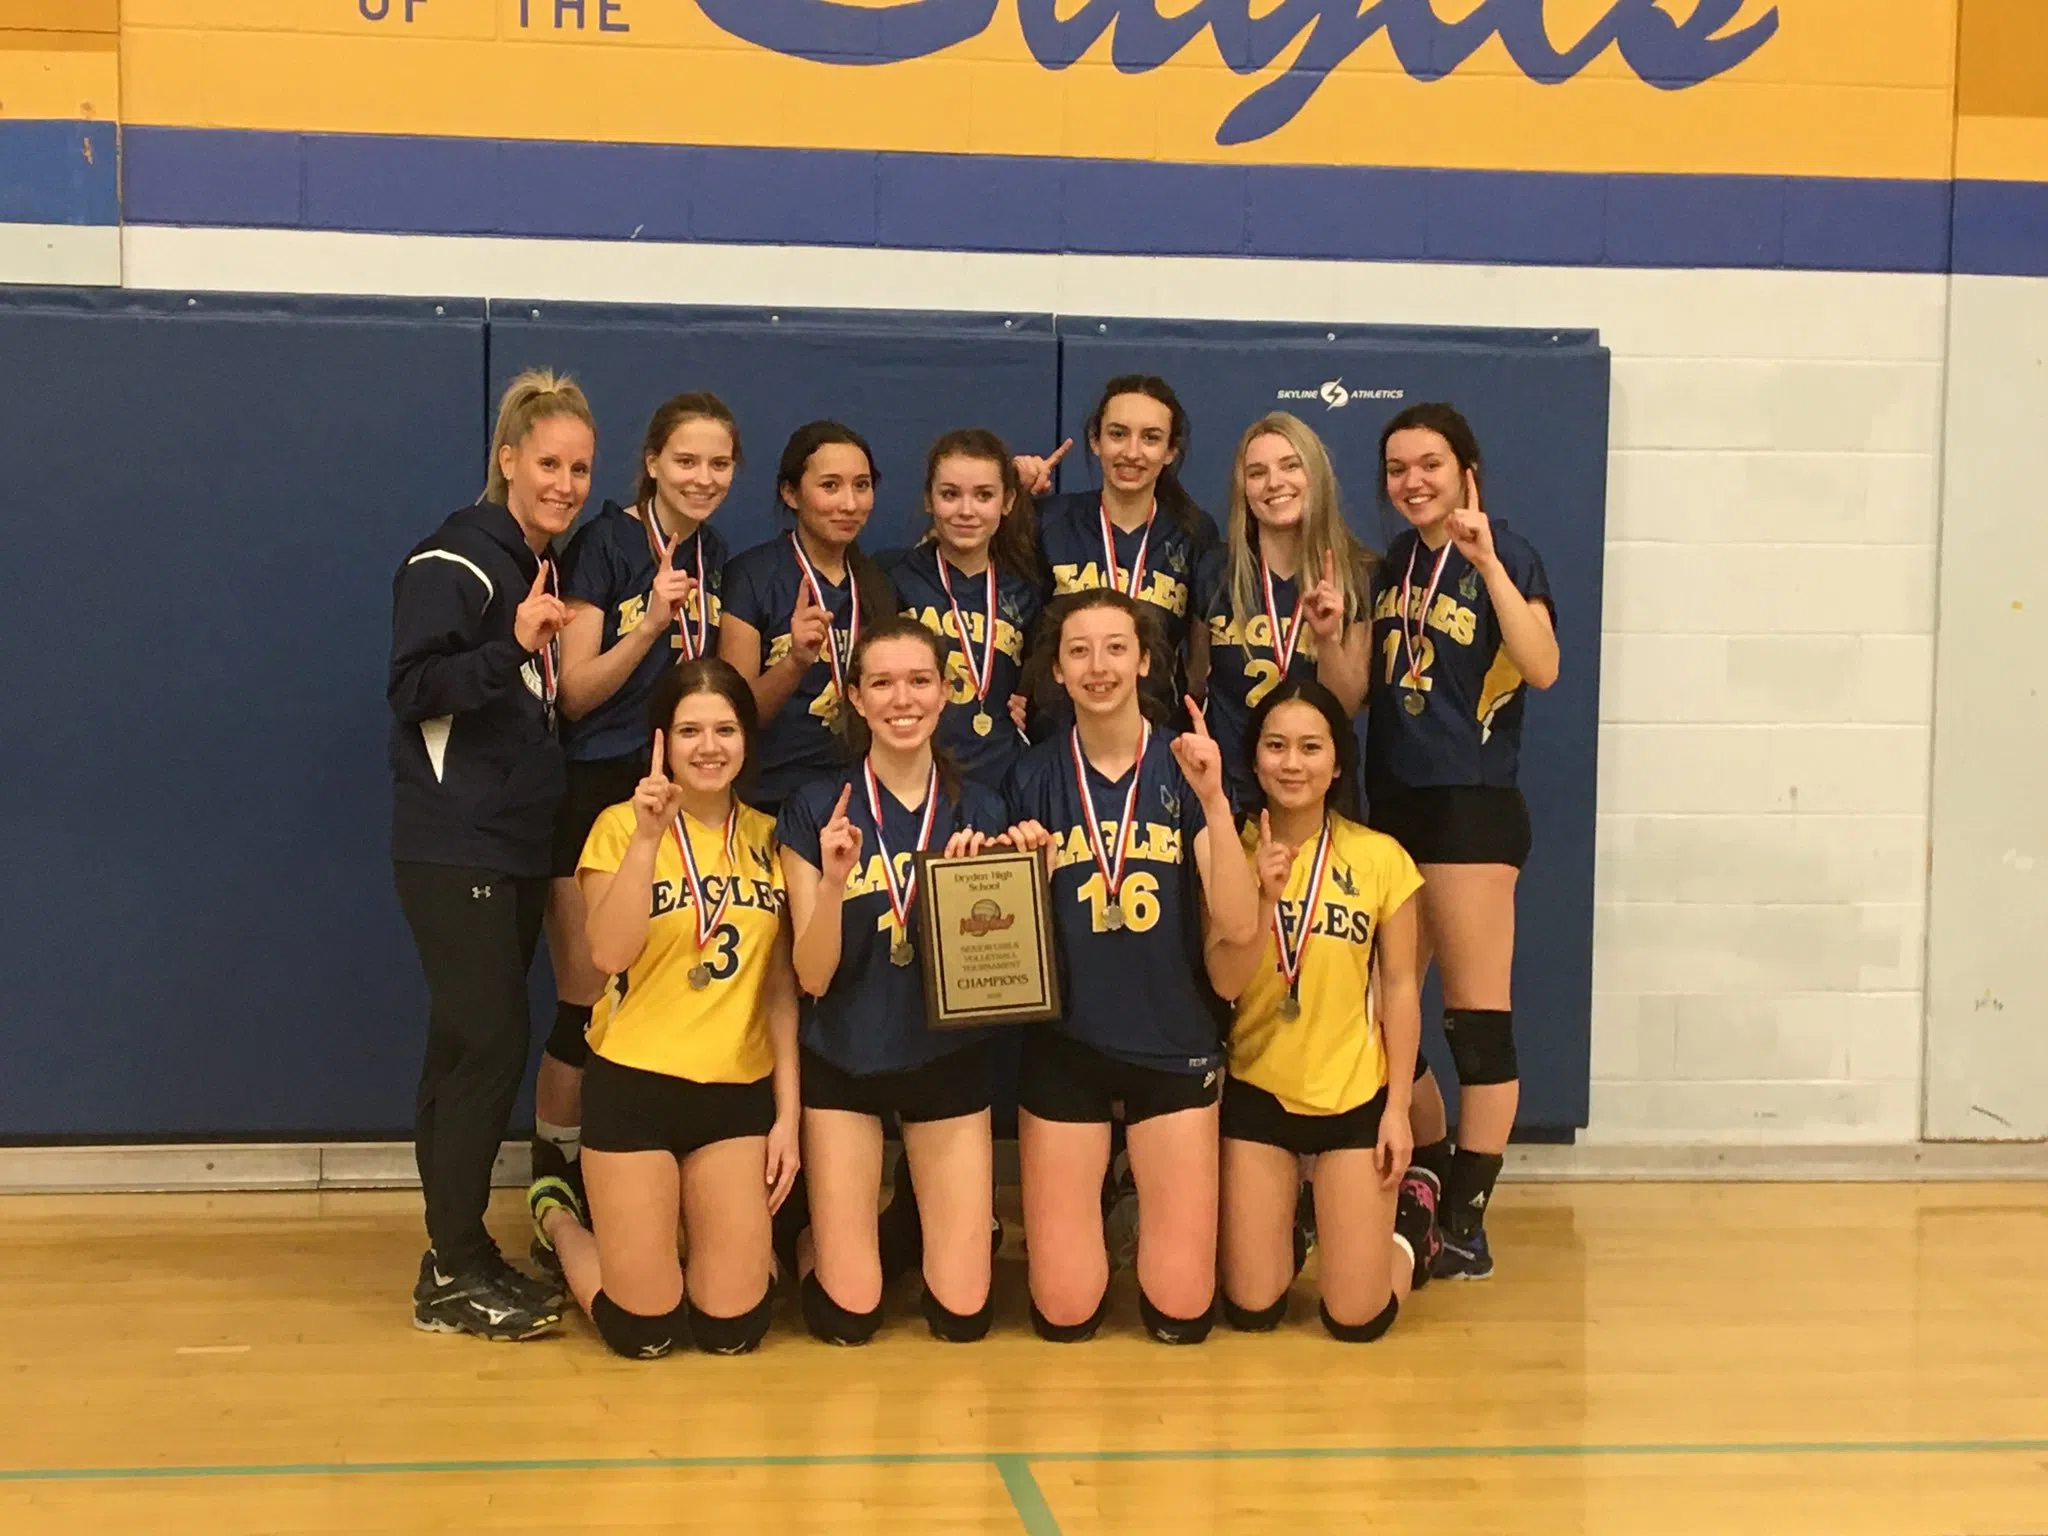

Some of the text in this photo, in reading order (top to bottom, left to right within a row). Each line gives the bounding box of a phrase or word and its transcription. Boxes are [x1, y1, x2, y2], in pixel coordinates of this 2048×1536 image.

[1277, 389, 1404, 399] SKYLINE ATHLETICS
[1383, 629, 1435, 692] 12
[649, 875, 787, 919] EAGLES
[1077, 871, 1160, 933] 16
[1278, 898, 1370, 945] GLES
[703, 923, 740, 980] 3
[957, 974, 1029, 990] CHAMPIONS
